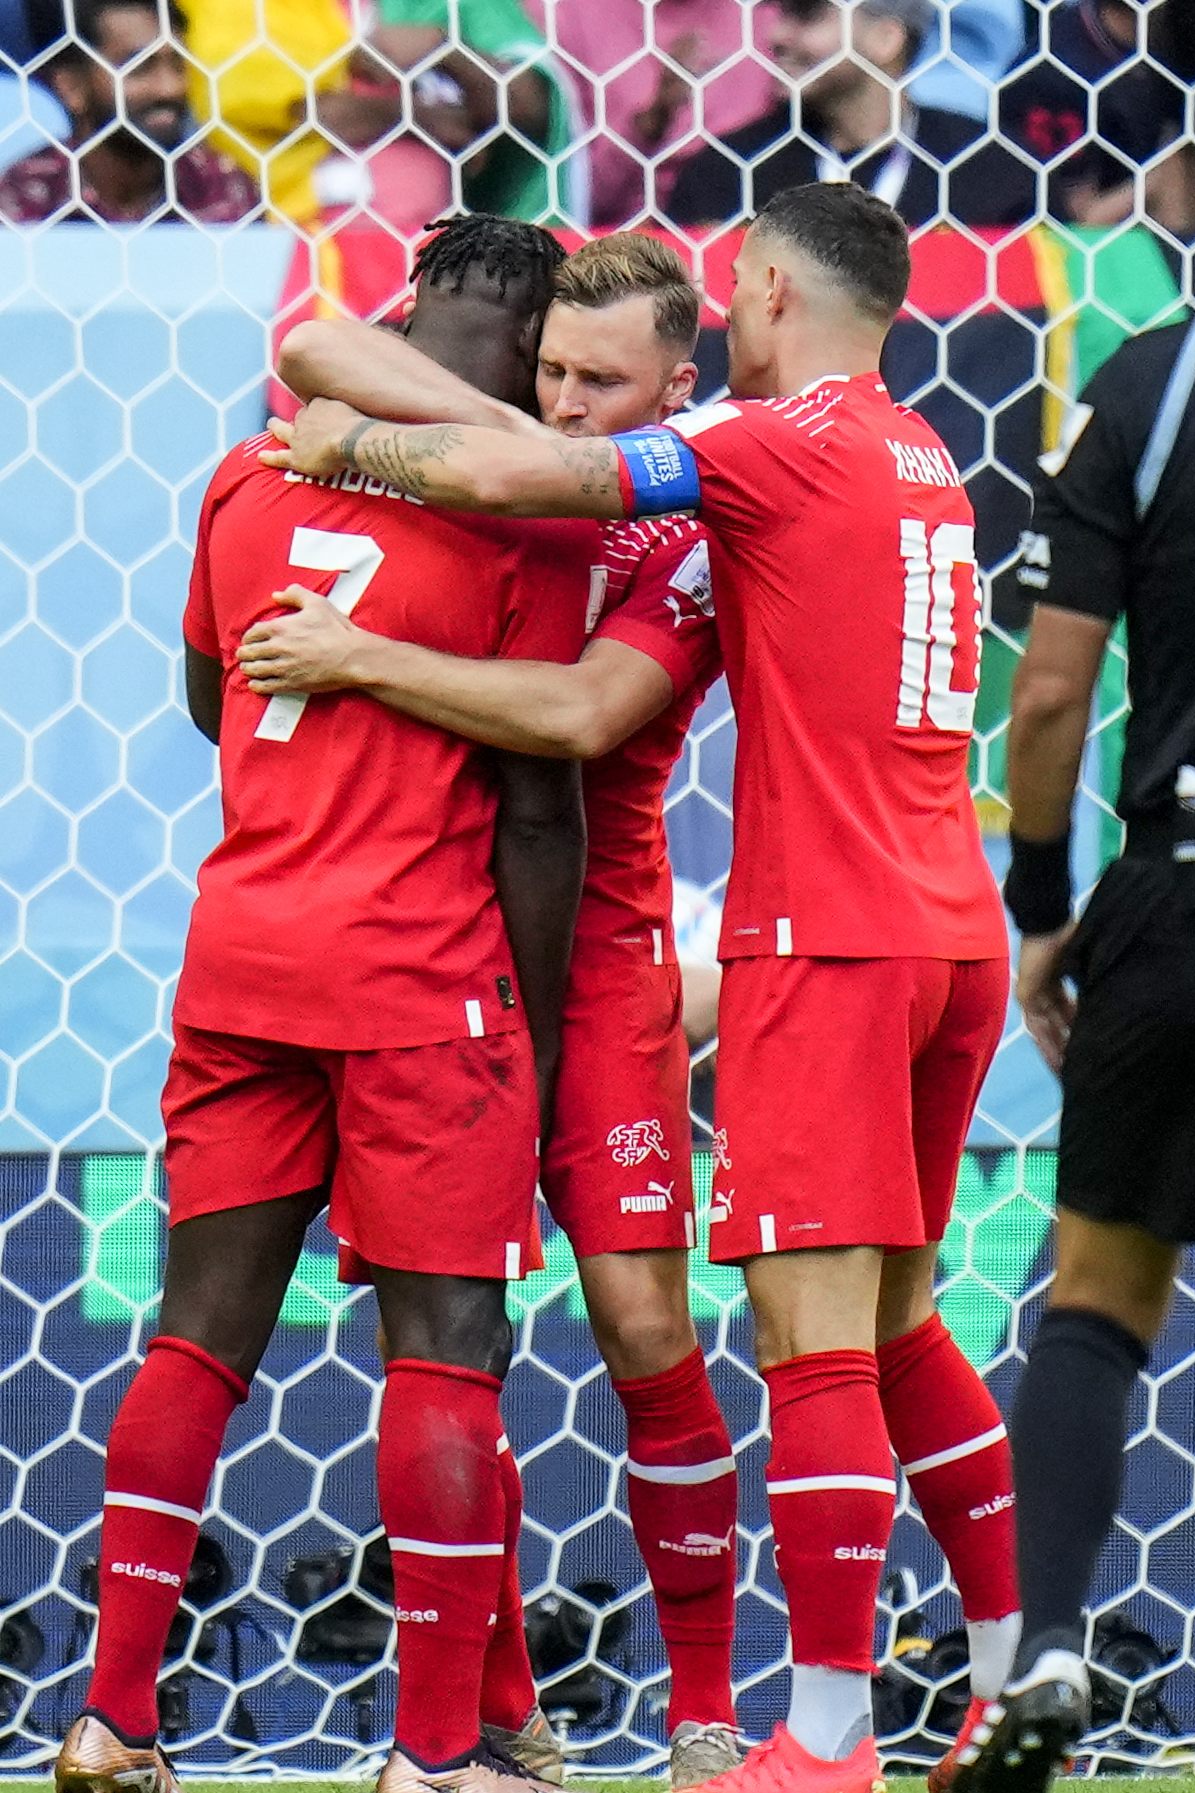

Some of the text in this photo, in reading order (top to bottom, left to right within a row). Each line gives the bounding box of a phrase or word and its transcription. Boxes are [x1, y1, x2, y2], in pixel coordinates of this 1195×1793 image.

[646, 437, 674, 482] UNITES
[660, 435, 684, 479] FOOTBALL
[253, 526, 386, 743] 7
[896, 518, 983, 732] 10
[620, 1195, 667, 1214] PUMA
[111, 1562, 181, 1587] suisse
[395, 1606, 439, 1623] isse
